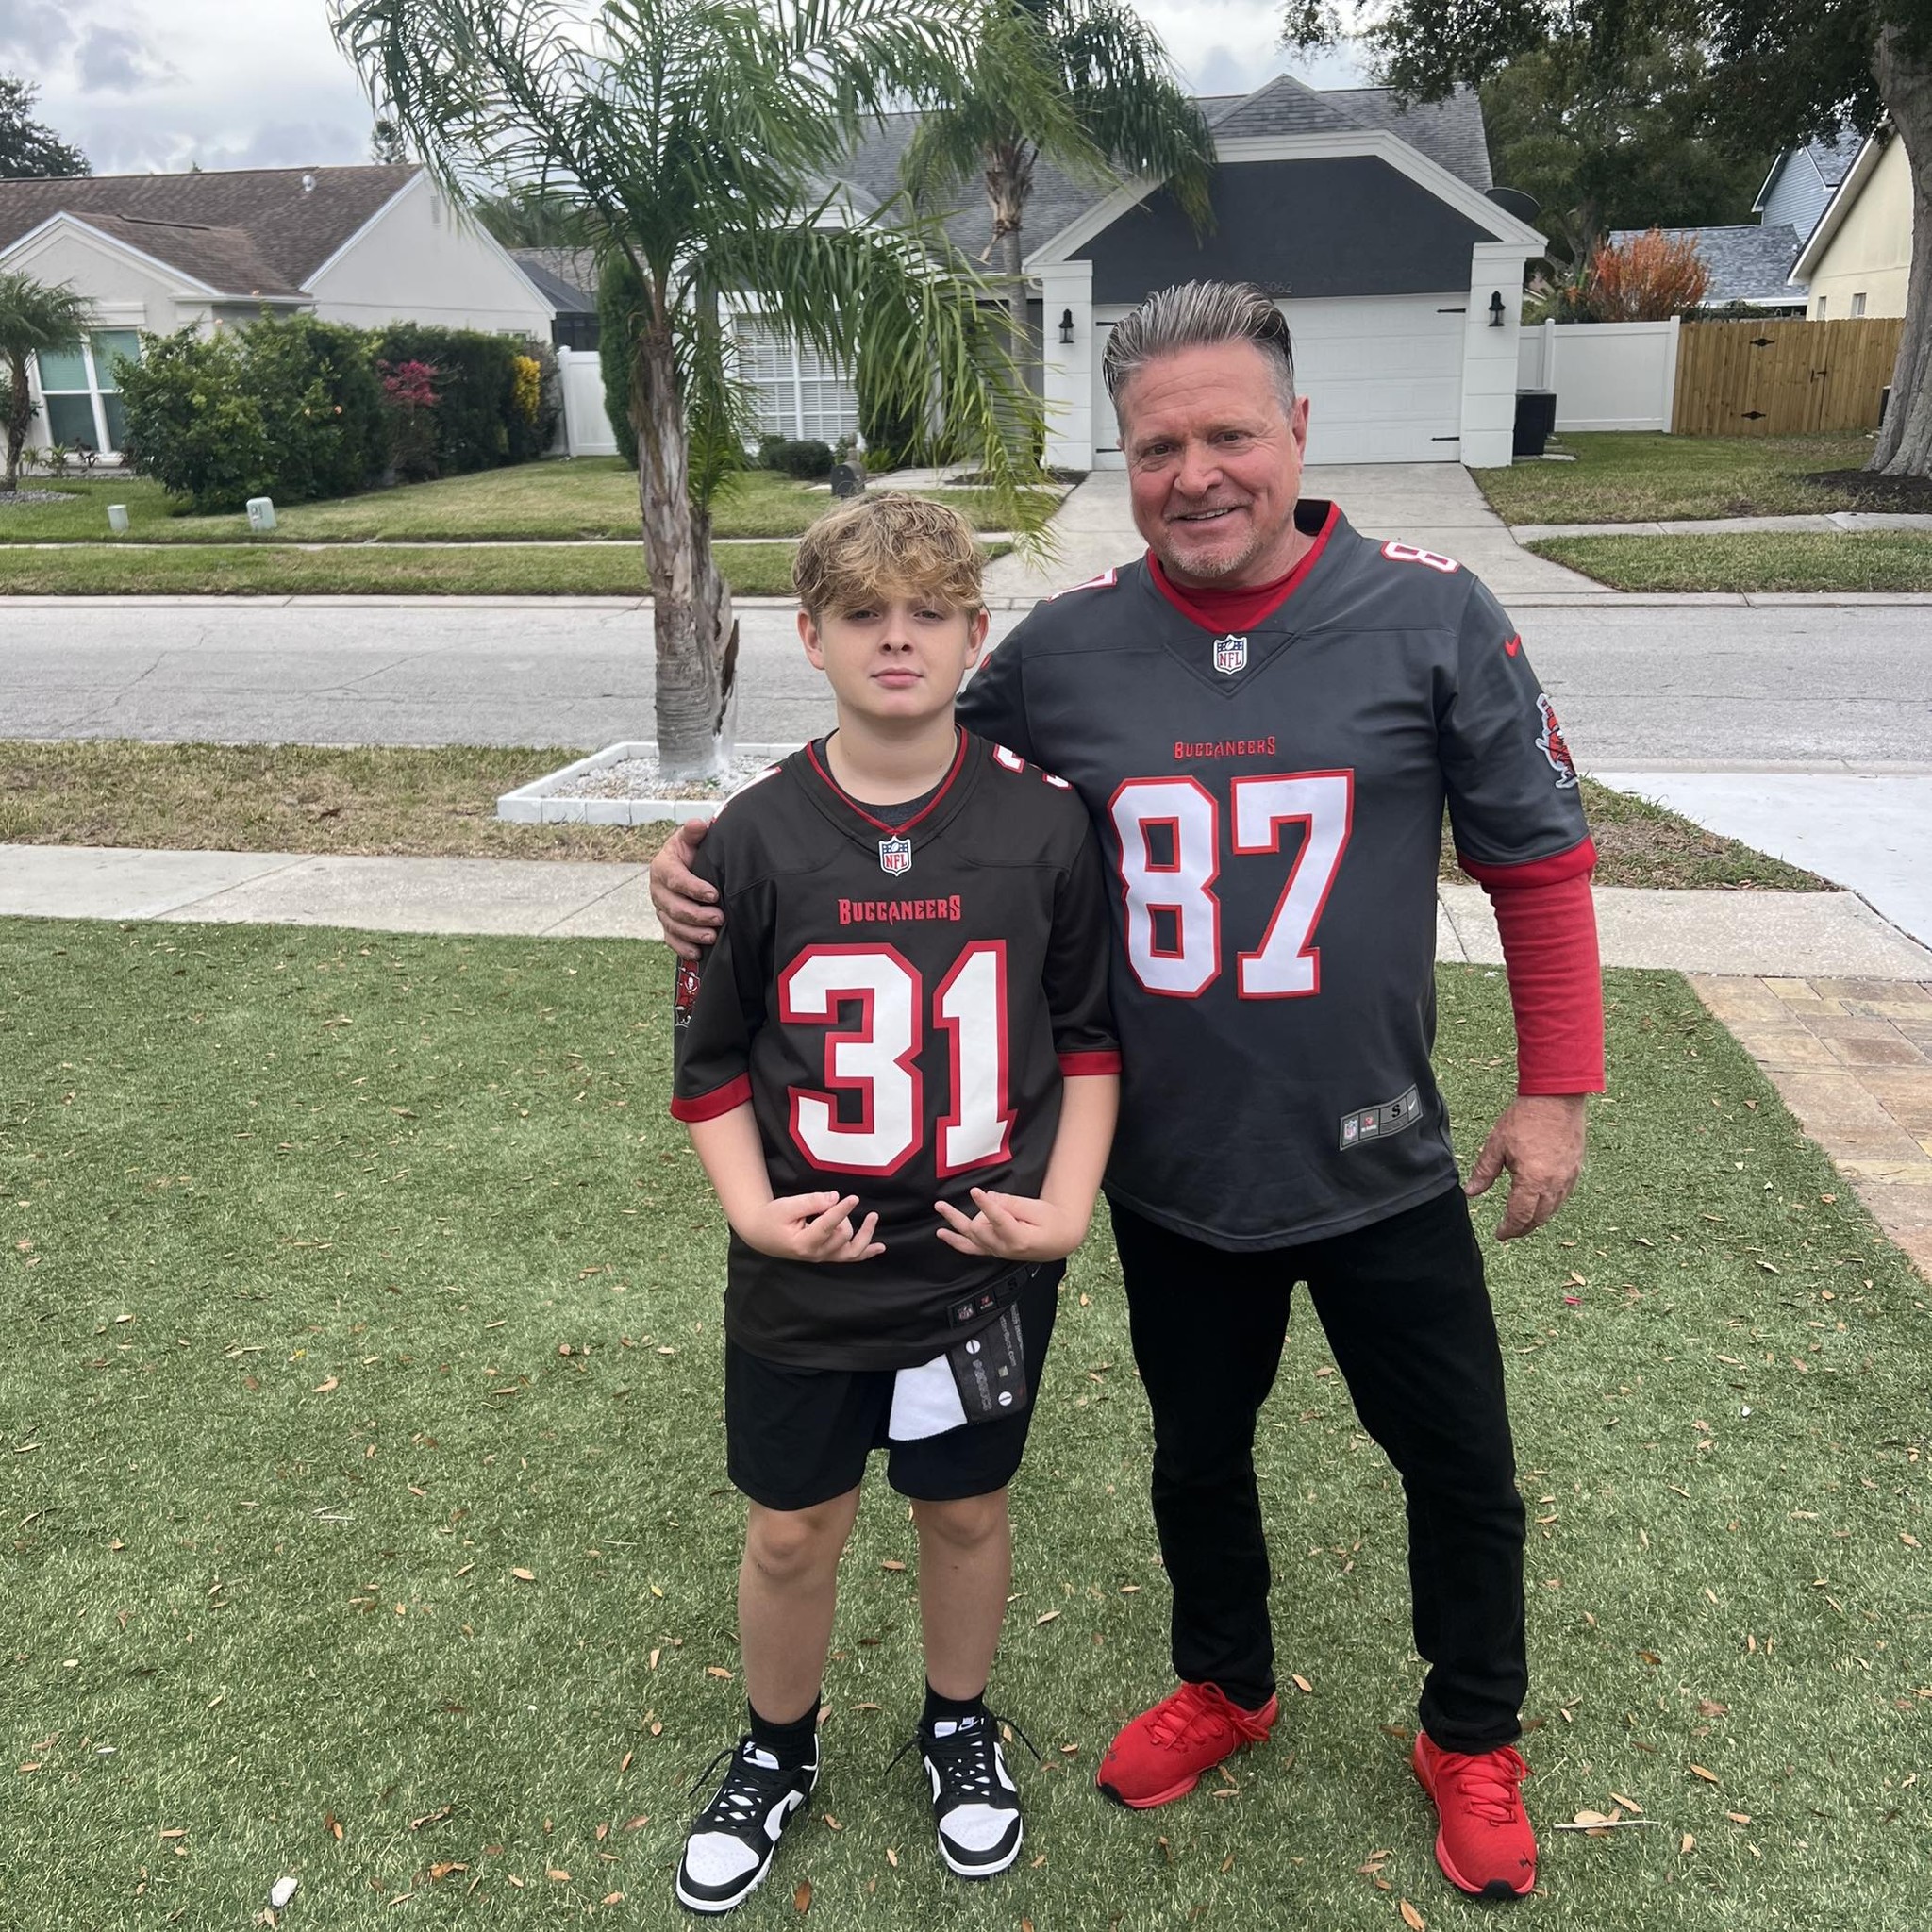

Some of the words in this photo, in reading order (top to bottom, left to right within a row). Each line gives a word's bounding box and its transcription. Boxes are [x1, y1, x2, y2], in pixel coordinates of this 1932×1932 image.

[1218, 651, 1242, 669] NFL
[1174, 736, 1276, 760] BUCCANEERS
[885, 853, 908, 869] NFL
[1108, 768, 1355, 1000] 87
[837, 894, 961, 925] BUCCANEERS
[778, 939, 1018, 1179] 31
[1391, 1104, 1401, 1118] S
